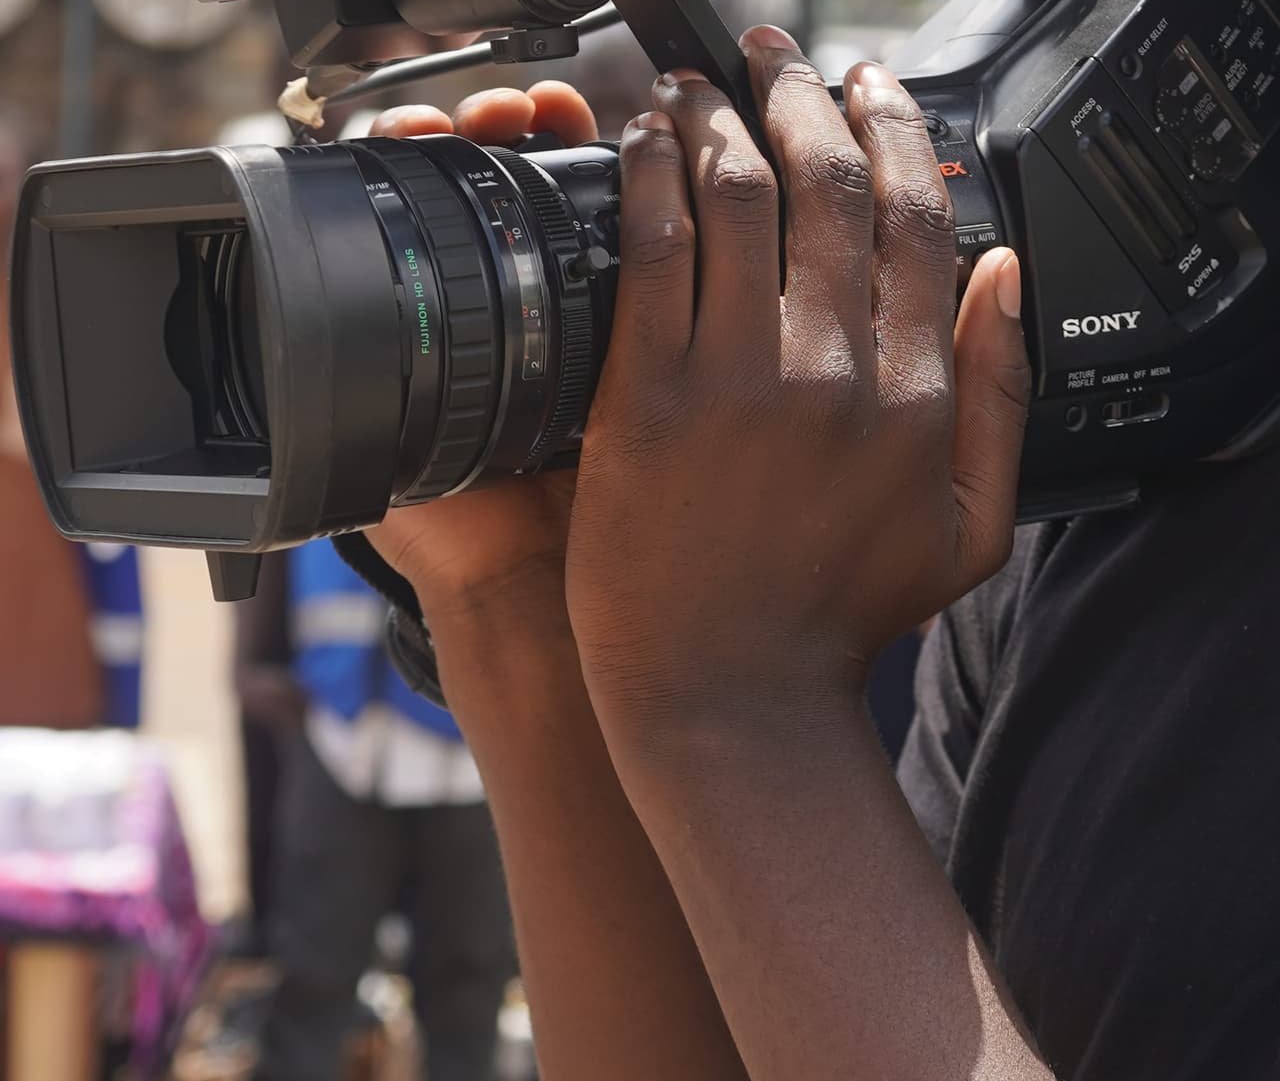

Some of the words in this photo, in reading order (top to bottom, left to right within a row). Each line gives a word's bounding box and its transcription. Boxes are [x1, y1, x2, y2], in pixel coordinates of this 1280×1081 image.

[1137, 39, 1153, 57] SLOT
[1150, 16, 1169, 42] SELECT
[1224, 58, 1242, 82] AUDIO
[1227, 63, 1248, 91] SELECT
[1070, 97, 1097, 129] ACCESS
[1193, 92, 1213, 117] AUDIO
[366, 182, 390, 192] AF/MF
[958, 233, 977, 244] FULL
[978, 232, 997, 242] AUTO
[405, 248, 420, 277] LENS
[1194, 265, 1213, 289] OPEN
[415, 282, 424, 298] HD
[418, 302, 430, 354] FUJINON
[1062, 311, 1141, 338] SONY
[1067, 377, 1095, 389] PROFILE
[1068, 369, 1096, 381] PICTURE
[1102, 373, 1129, 384] CAMERA
[1133, 369, 1147, 379] OFF
[1150, 366, 1171, 377] MEDIA
